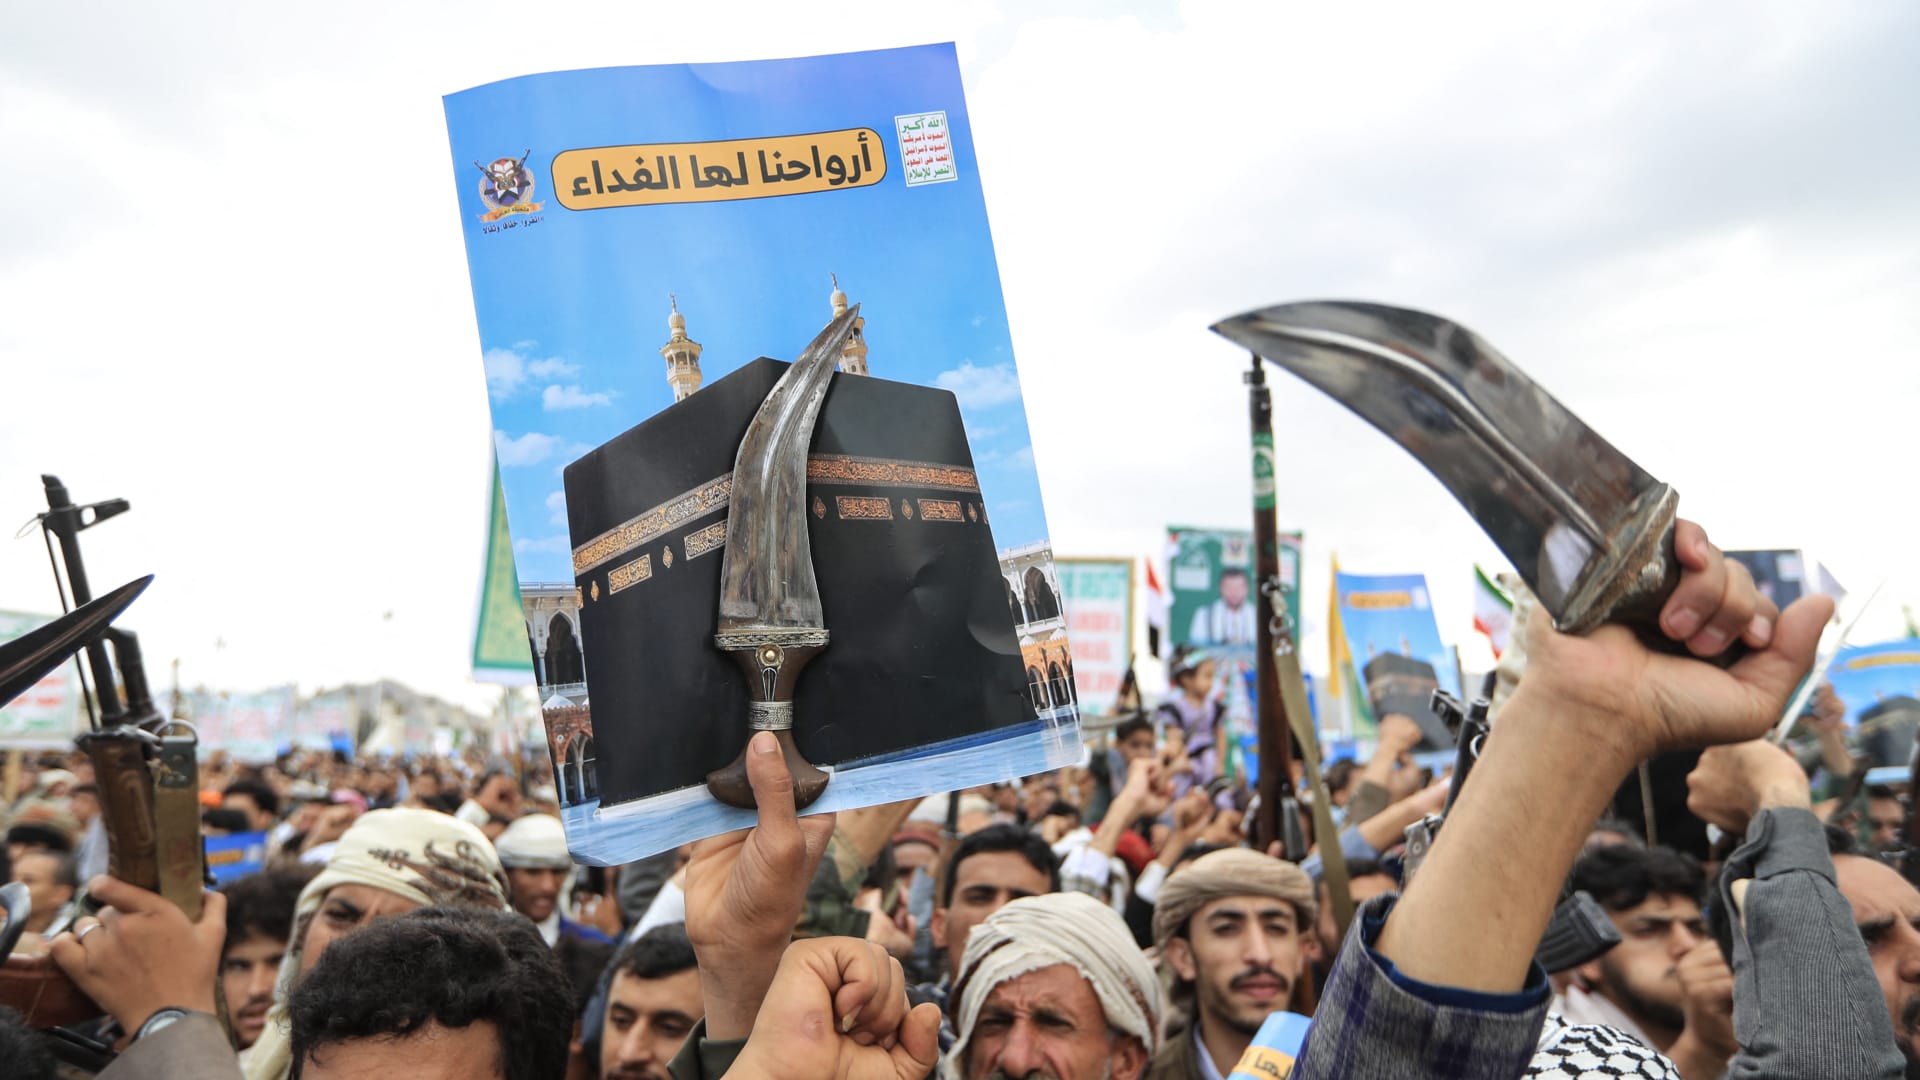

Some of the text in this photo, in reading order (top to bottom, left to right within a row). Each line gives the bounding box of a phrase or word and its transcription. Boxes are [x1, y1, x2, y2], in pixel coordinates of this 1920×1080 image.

[927, 116, 944, 128] الله
[572, 131, 872, 197] أرواحنا لها الفداء
